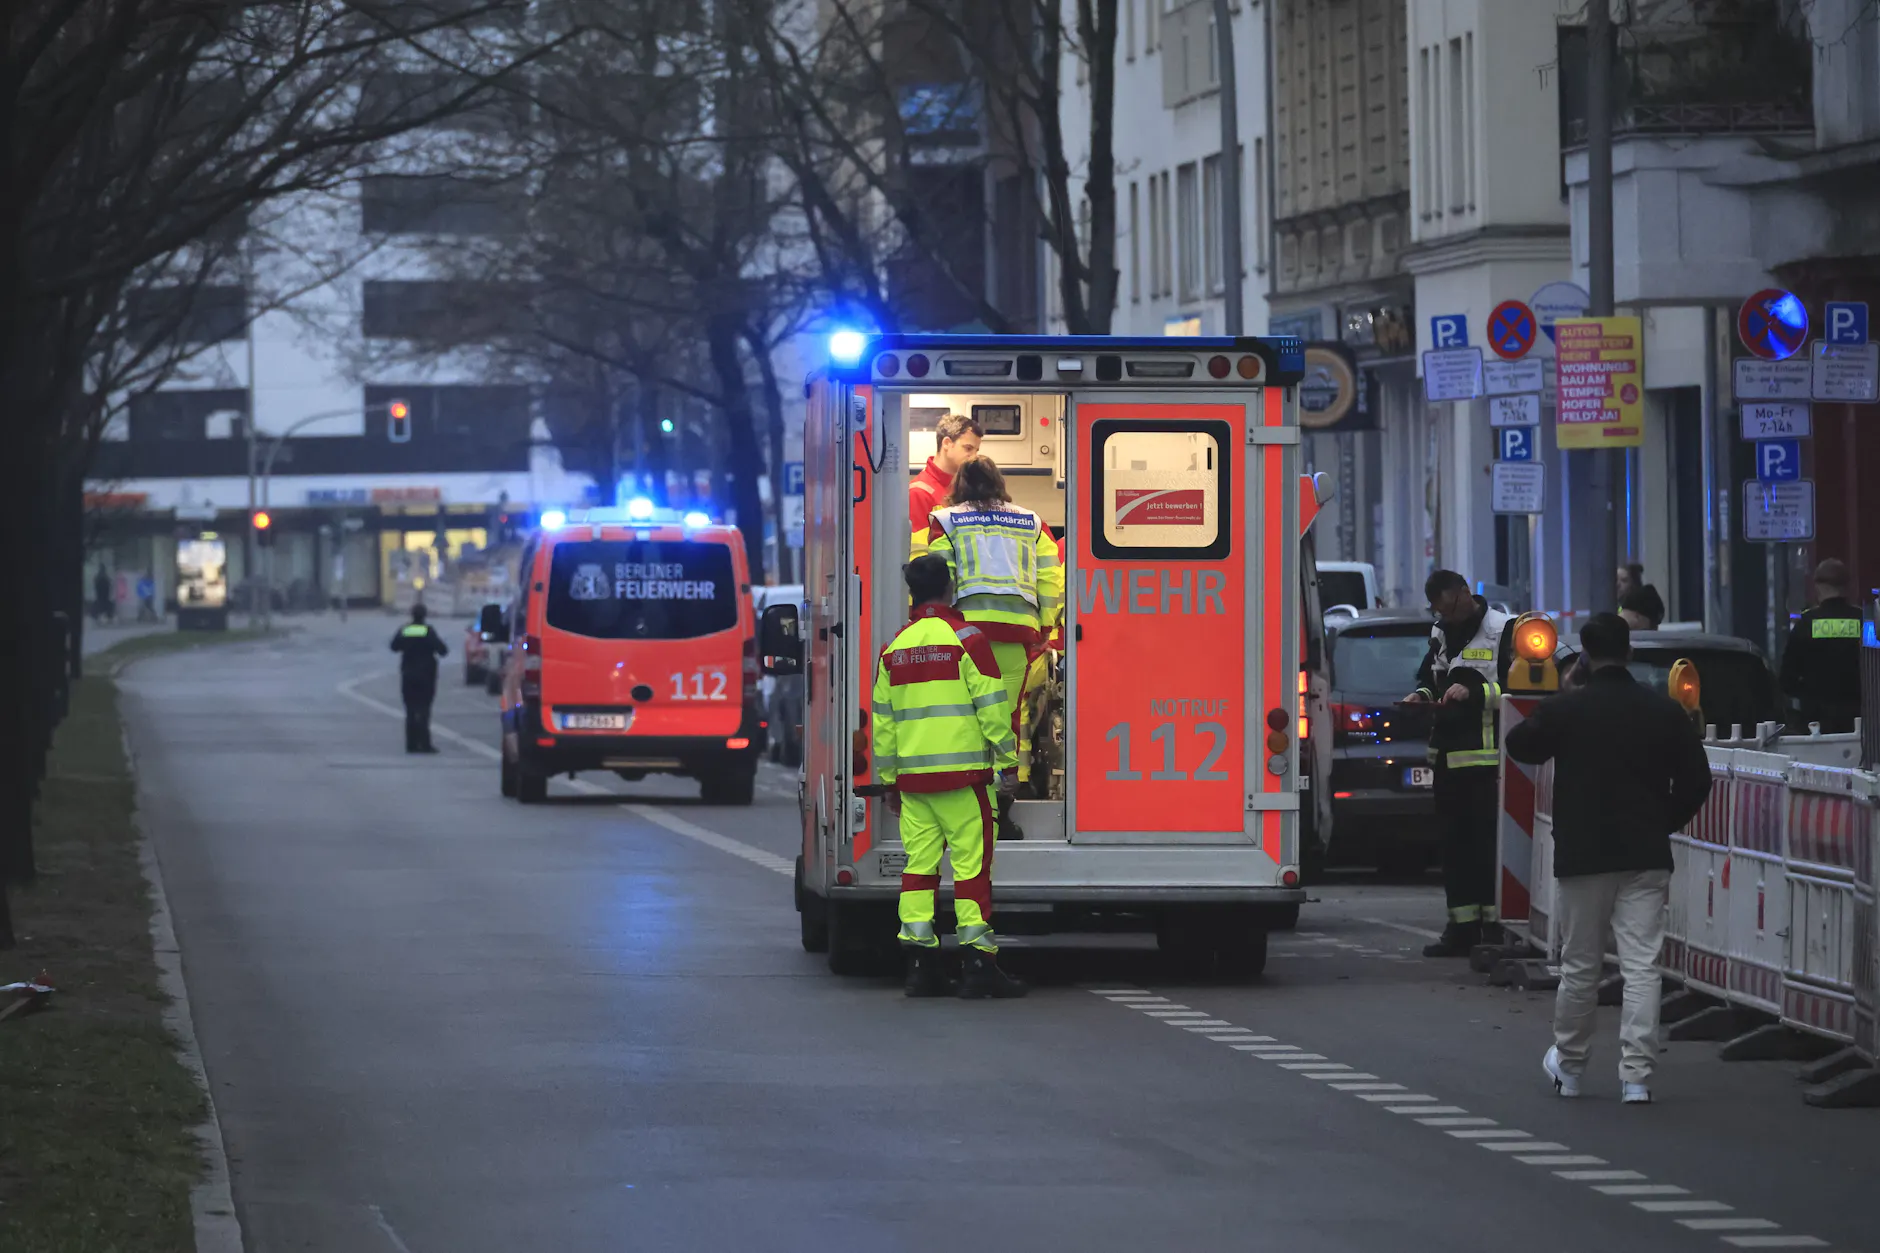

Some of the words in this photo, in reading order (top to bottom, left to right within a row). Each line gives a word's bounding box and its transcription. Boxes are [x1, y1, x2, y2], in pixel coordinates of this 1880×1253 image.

[1832, 308, 1855, 340] P
[1437, 319, 1457, 347] P
[1561, 375, 1585, 386] BAU
[1587, 375, 1606, 385] AM
[1562, 398, 1601, 409] HOFER
[1562, 411, 1597, 421] FELD?
[1600, 411, 1618, 420] JA!
[1755, 406, 1795, 420] Mo-Fr
[1760, 421, 1793, 434] 7-14h
[1505, 430, 1523, 458] P
[1764, 444, 1787, 477] P
[951, 514, 991, 524] Leitende
[993, 515, 1034, 526] Notärztin
[614, 563, 684, 579] BERLINER
[615, 580, 715, 600] FEUERWEHR
[1078, 569, 1227, 614] WEHR
[1813, 620, 1860, 636] POLZEI
[910, 645, 938, 655] BERLER
[910, 653, 952, 664] FEUWEHR
[669, 672, 728, 701] 112
[1151, 699, 1229, 717] NOTRUF
[1105, 721, 1229, 781] 112
